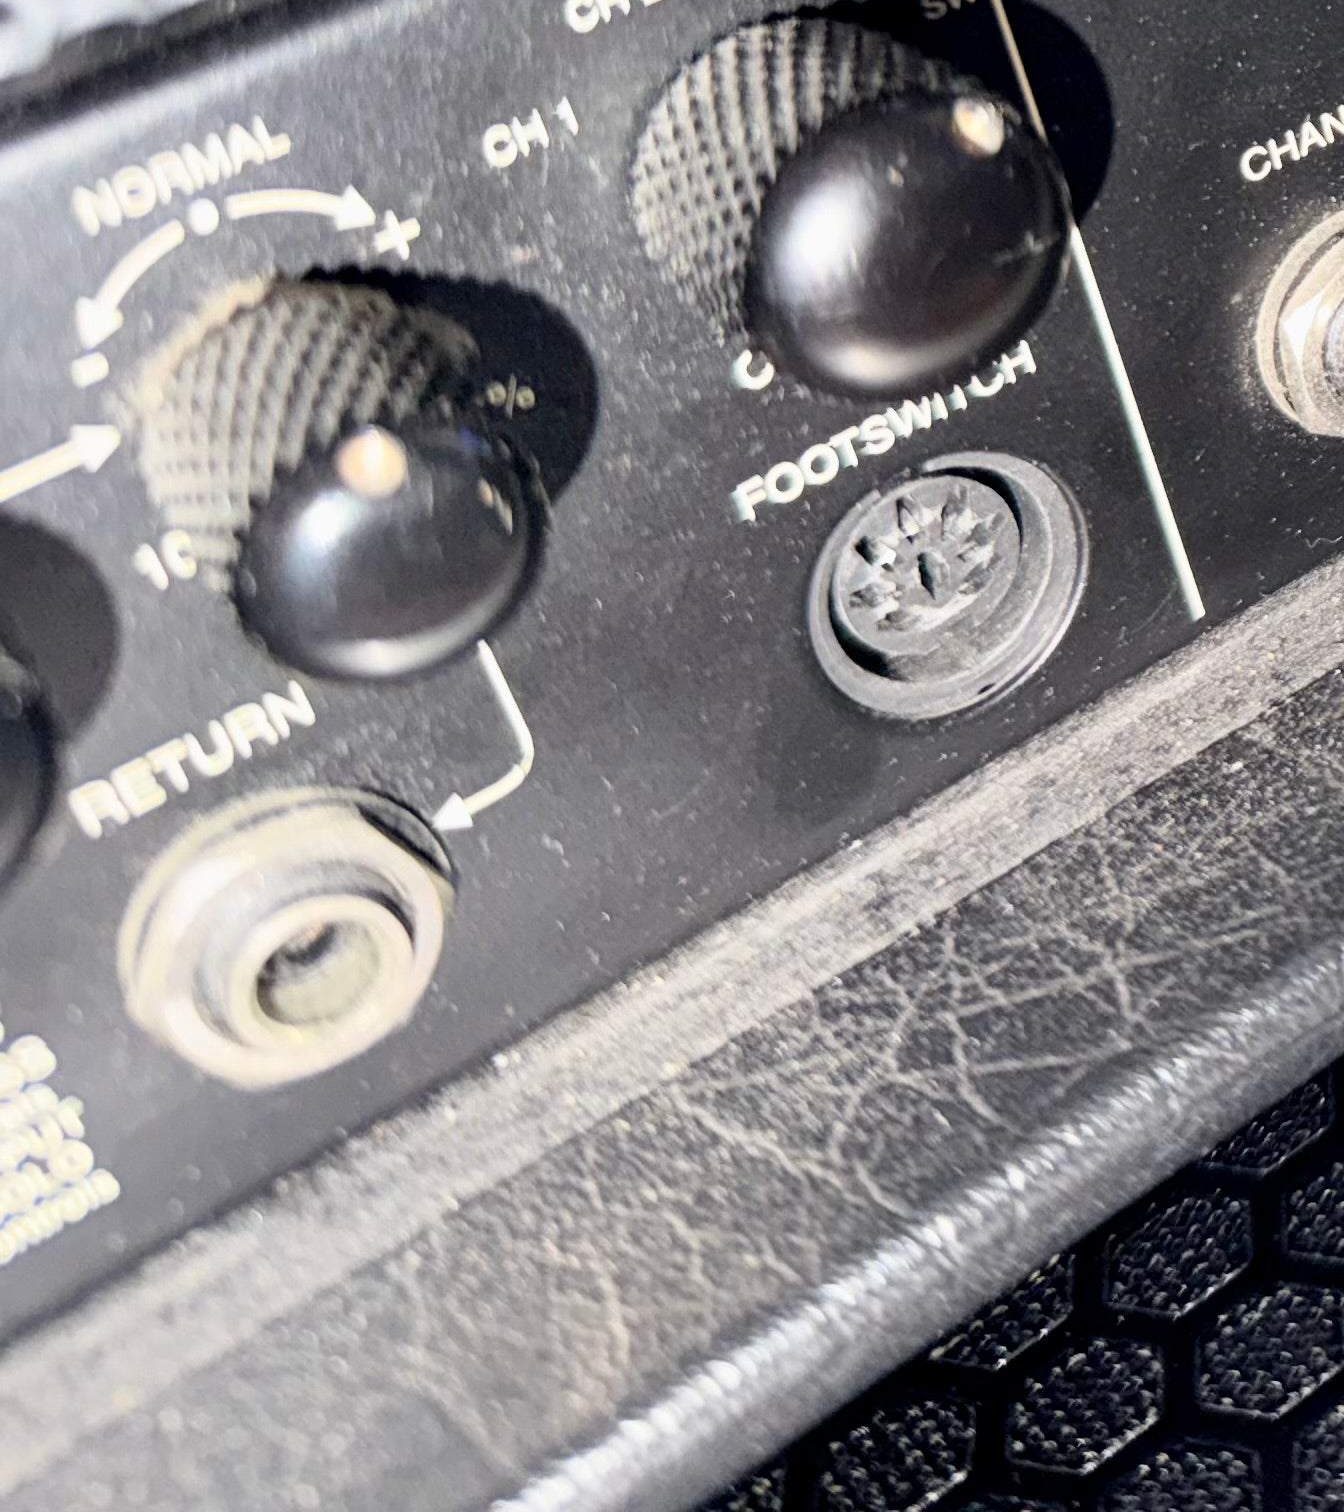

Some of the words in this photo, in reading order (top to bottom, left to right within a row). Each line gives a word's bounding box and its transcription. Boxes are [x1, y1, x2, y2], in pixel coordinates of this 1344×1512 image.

[70, 114, 291, 238] NORMAL
[482, 108, 549, 168] CH
[554, 95, 579, 136] 1
[67, 679, 317, 839] RETURN
